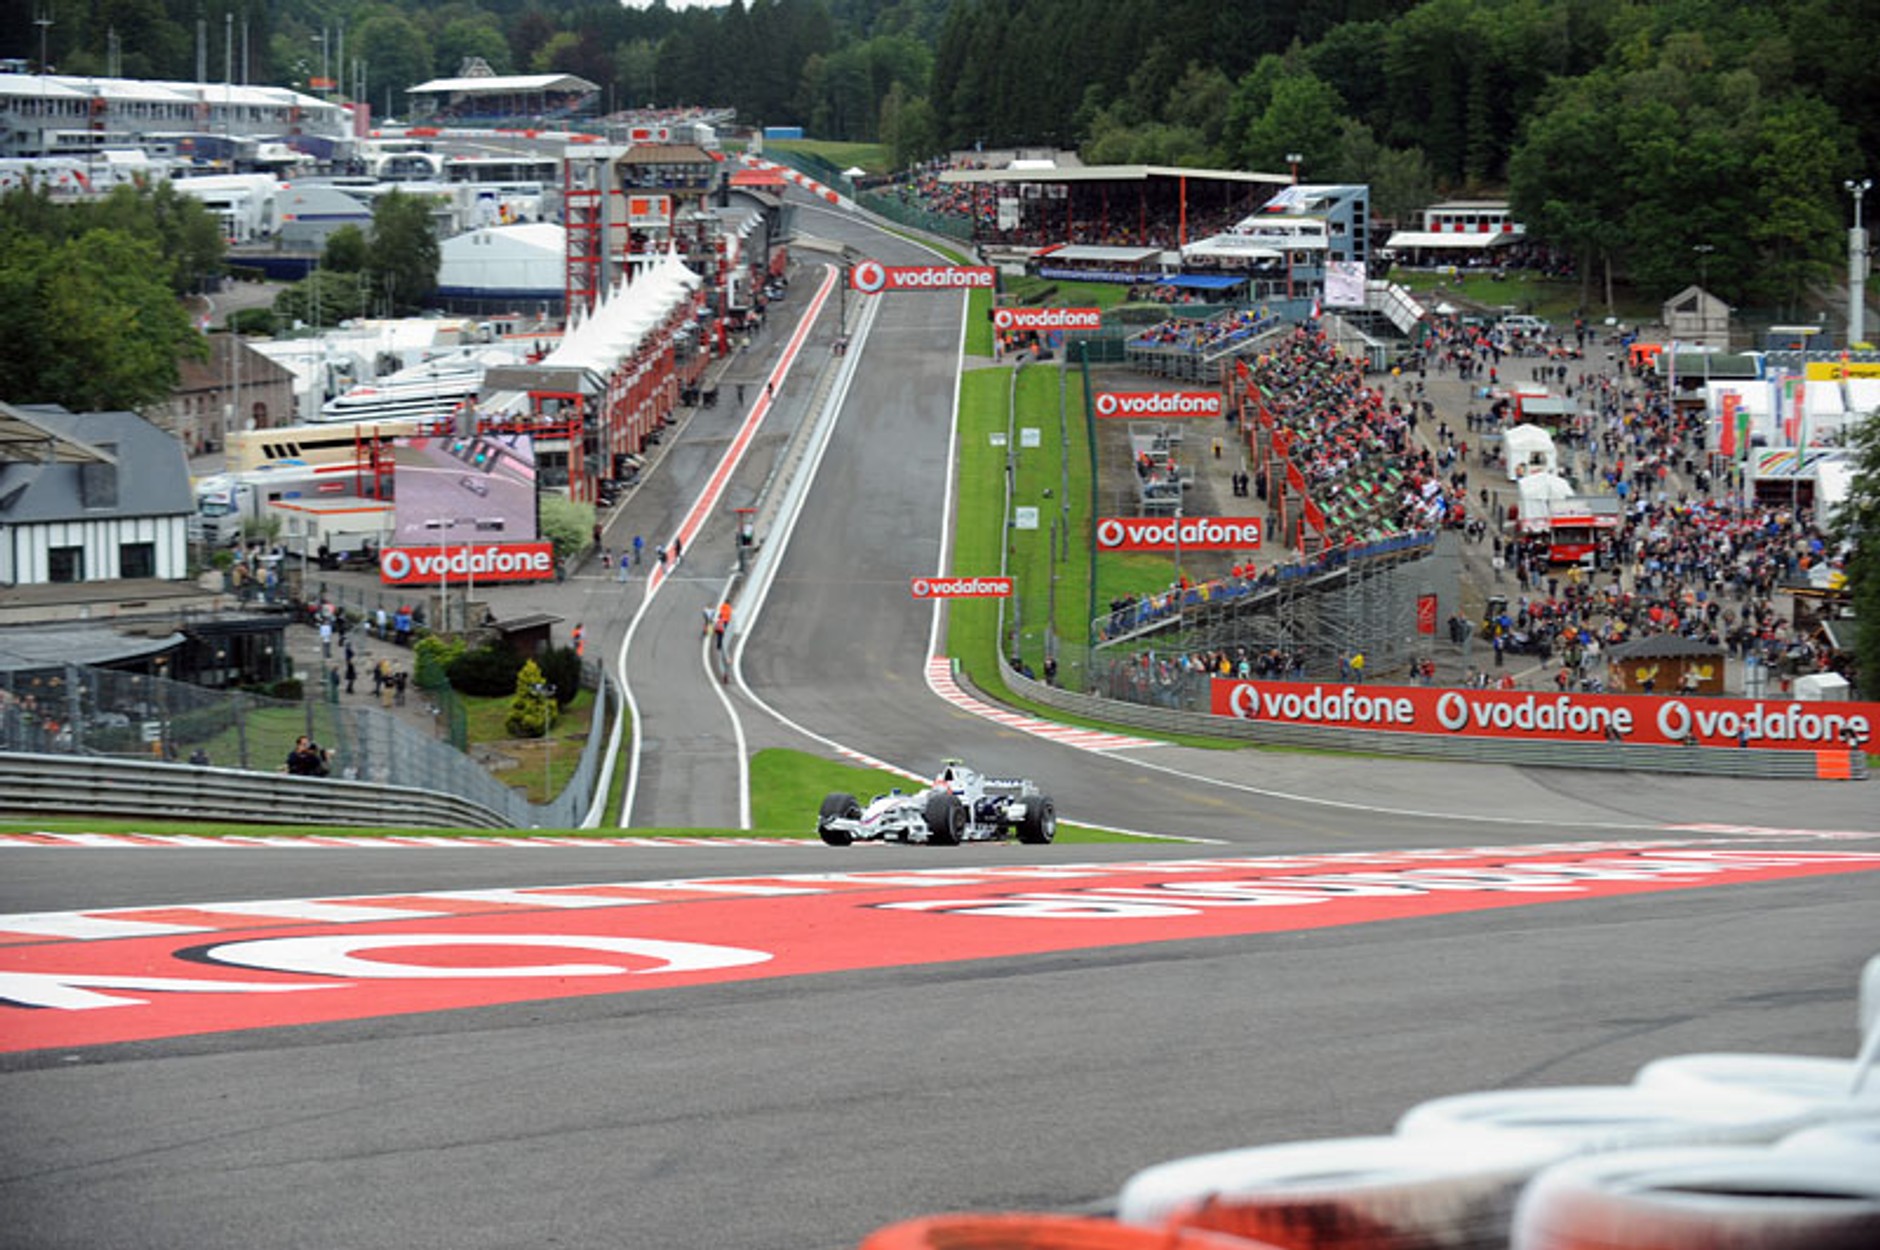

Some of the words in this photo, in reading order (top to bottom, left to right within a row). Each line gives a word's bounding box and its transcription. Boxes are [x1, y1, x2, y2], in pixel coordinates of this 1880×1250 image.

[893, 268, 993, 287] vodafone
[1014, 309, 1099, 327] vodafone
[1119, 393, 1219, 412] vodafone
[1128, 519, 1259, 544] vodafone
[413, 548, 550, 575] vodafone
[931, 579, 1010, 594] vodafone
[1264, 687, 1414, 723] vodafone
[1471, 696, 1633, 733] vodafone
[1695, 703, 1869, 742] vodafone
